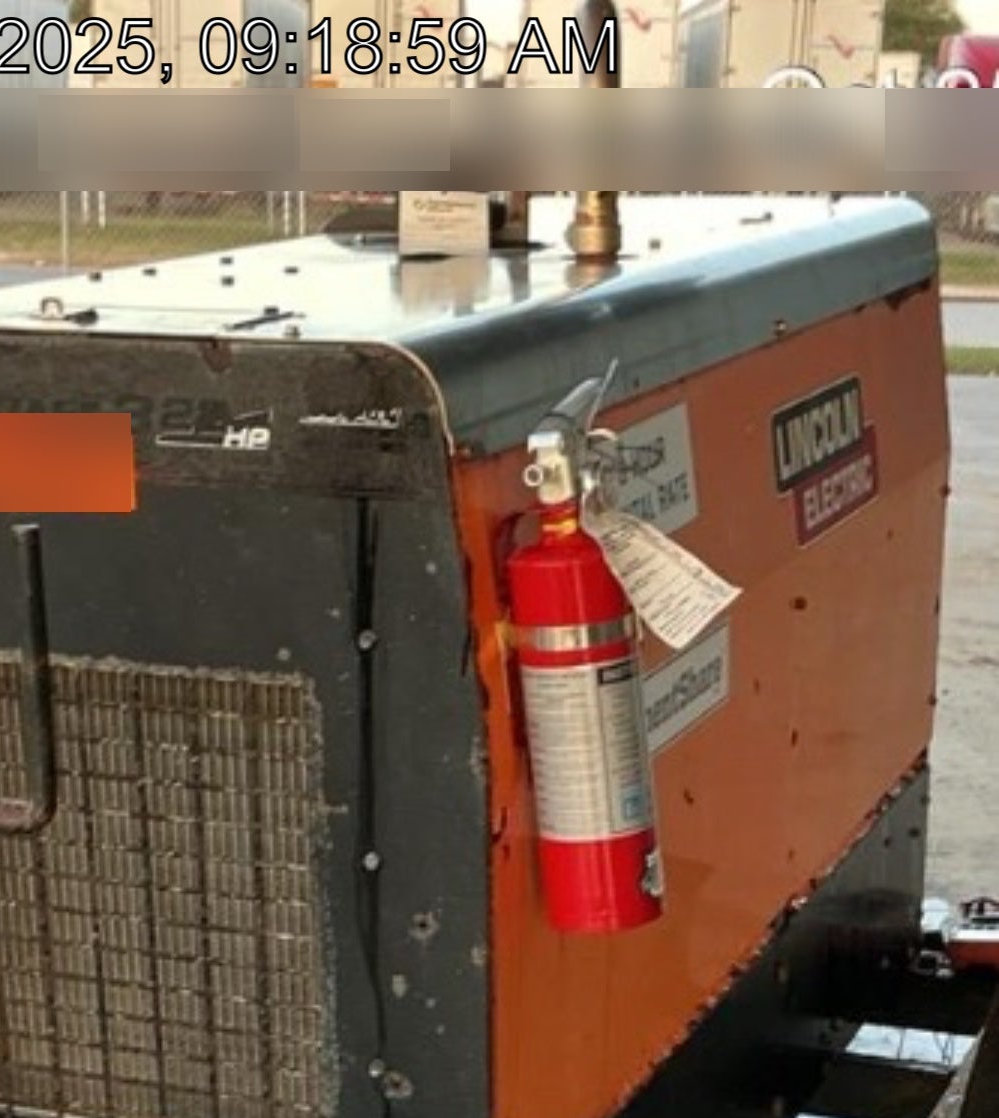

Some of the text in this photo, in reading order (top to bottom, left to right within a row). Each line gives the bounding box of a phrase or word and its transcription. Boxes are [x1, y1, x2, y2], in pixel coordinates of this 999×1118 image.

[222, 425, 271, 450] HP
[776, 387, 860, 481] LINCOLN
[803, 453, 875, 531] ELECTRIC
